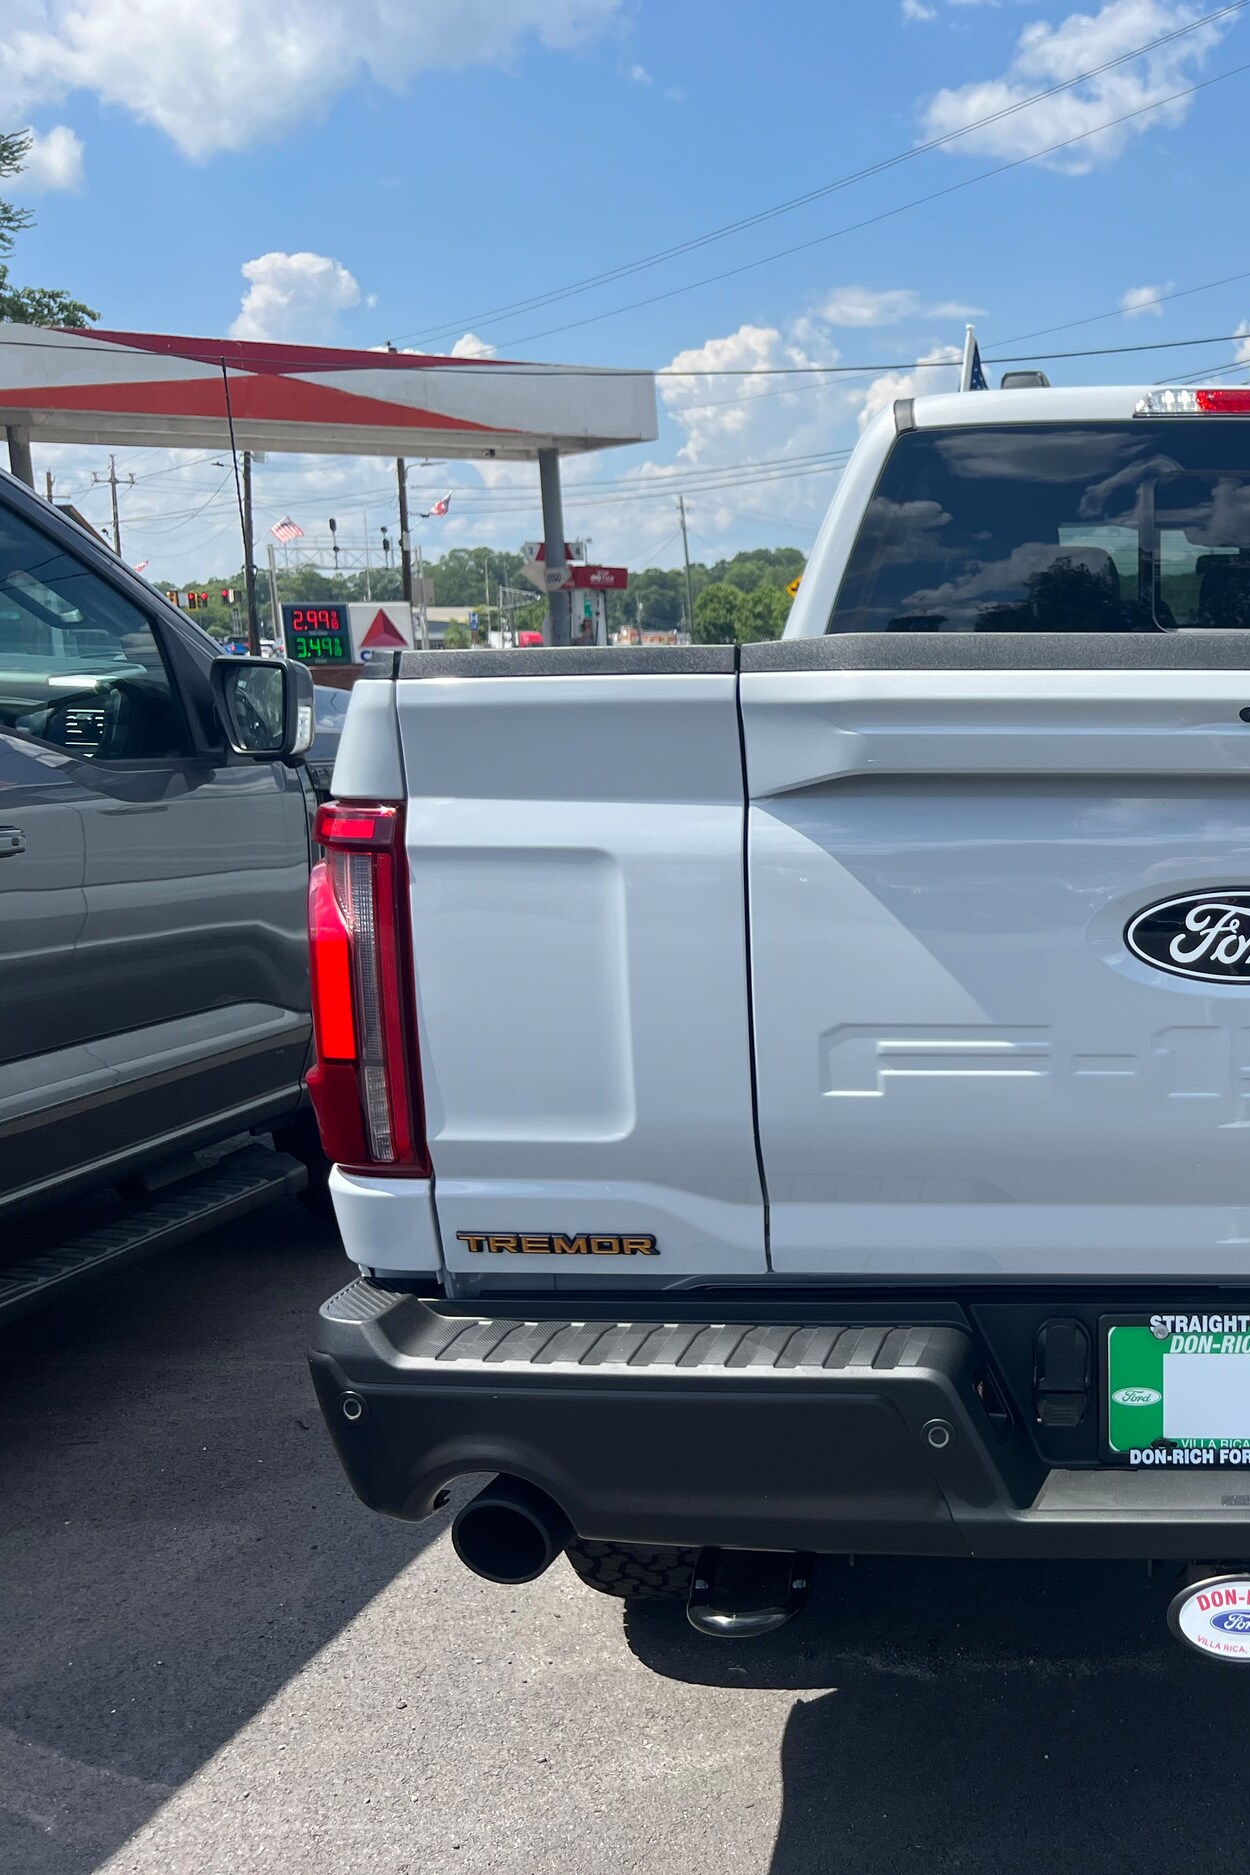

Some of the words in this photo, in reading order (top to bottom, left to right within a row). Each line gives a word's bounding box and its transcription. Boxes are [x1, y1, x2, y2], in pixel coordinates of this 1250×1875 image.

[296, 637, 333, 658] 3.49
[456, 1230, 661, 1256] TREMOR
[1150, 1315, 1250, 1333] STRAIGHT
[1122, 1390, 1152, 1403] Ford
[1130, 1449, 1213, 1465] DON-RICH
[1197, 1635, 1221, 1650] VILLA
[1223, 1644, 1248, 1654] RICA,
